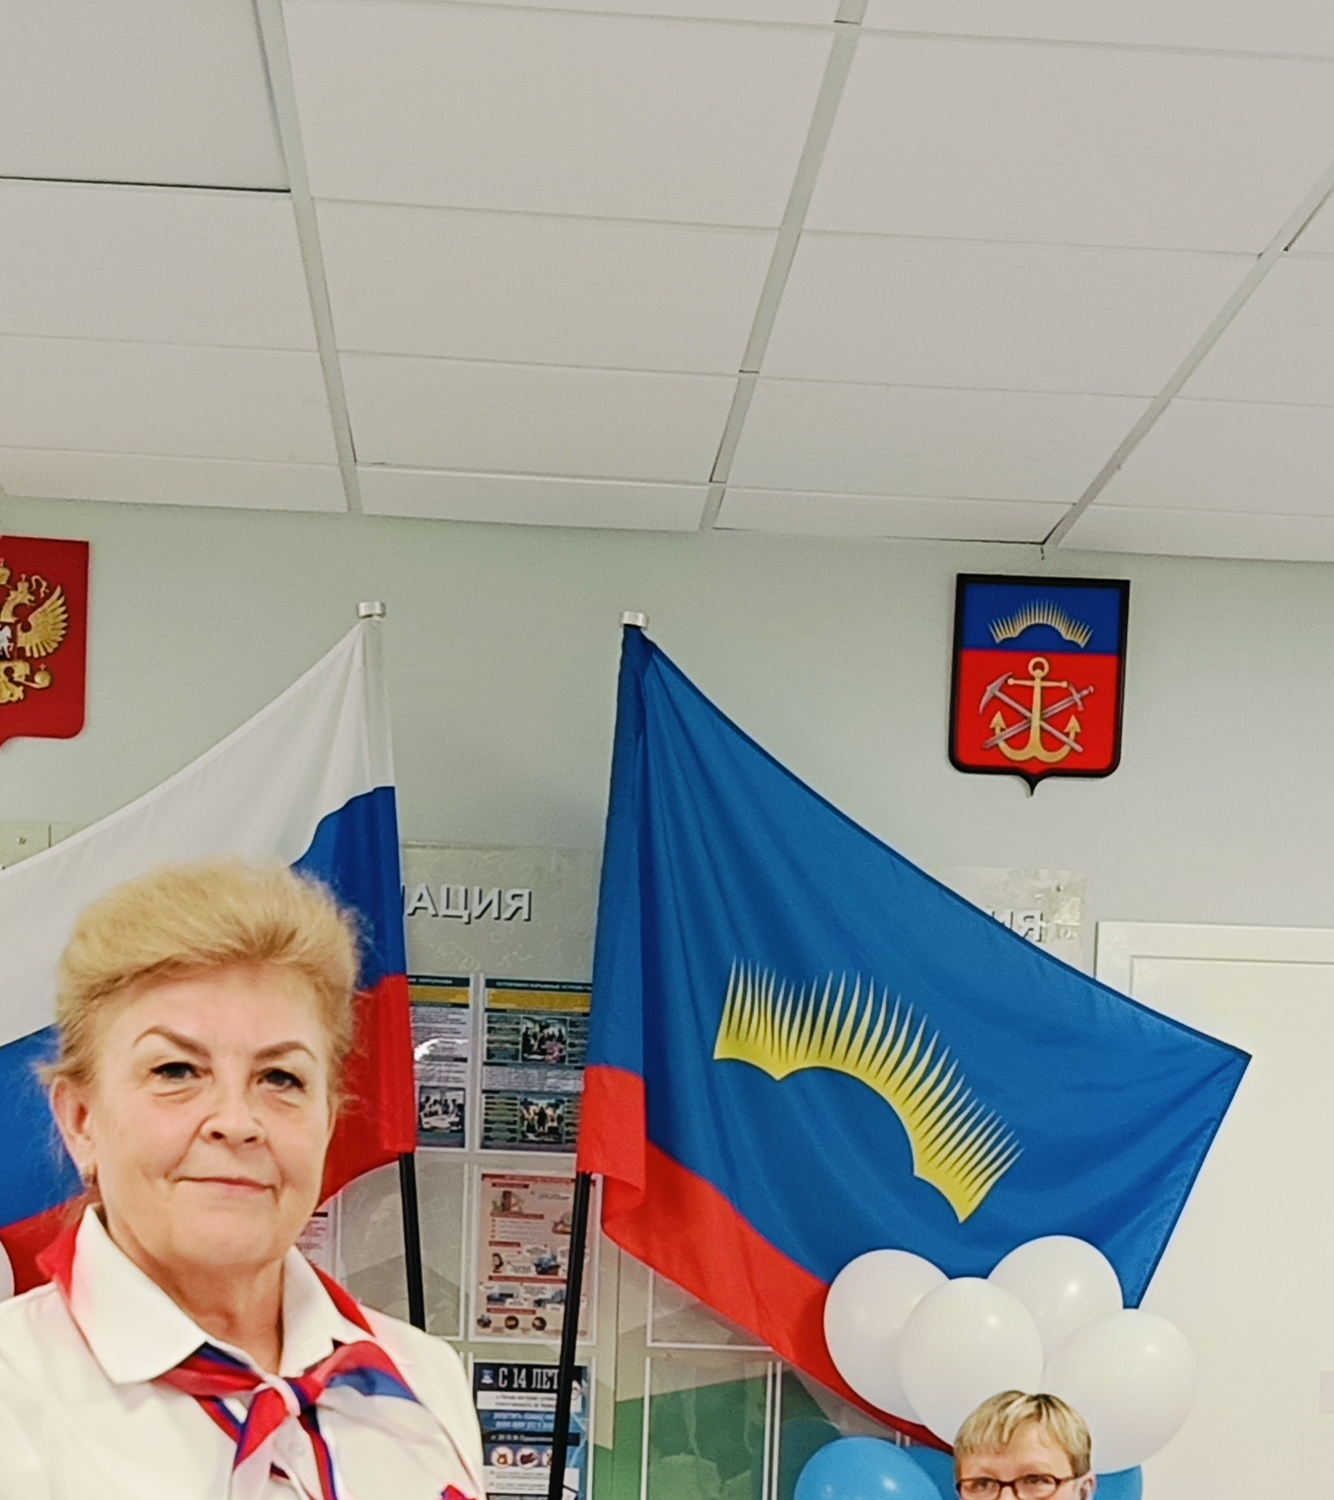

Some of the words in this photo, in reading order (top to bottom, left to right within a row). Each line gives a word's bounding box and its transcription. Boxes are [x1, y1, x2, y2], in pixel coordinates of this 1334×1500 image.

[402, 883, 532, 925] АЦИЯ
[498, 1366, 509, 1388] С
[512, 1367, 527, 1389] 14
[531, 1369, 559, 1390] ЛЕТ
